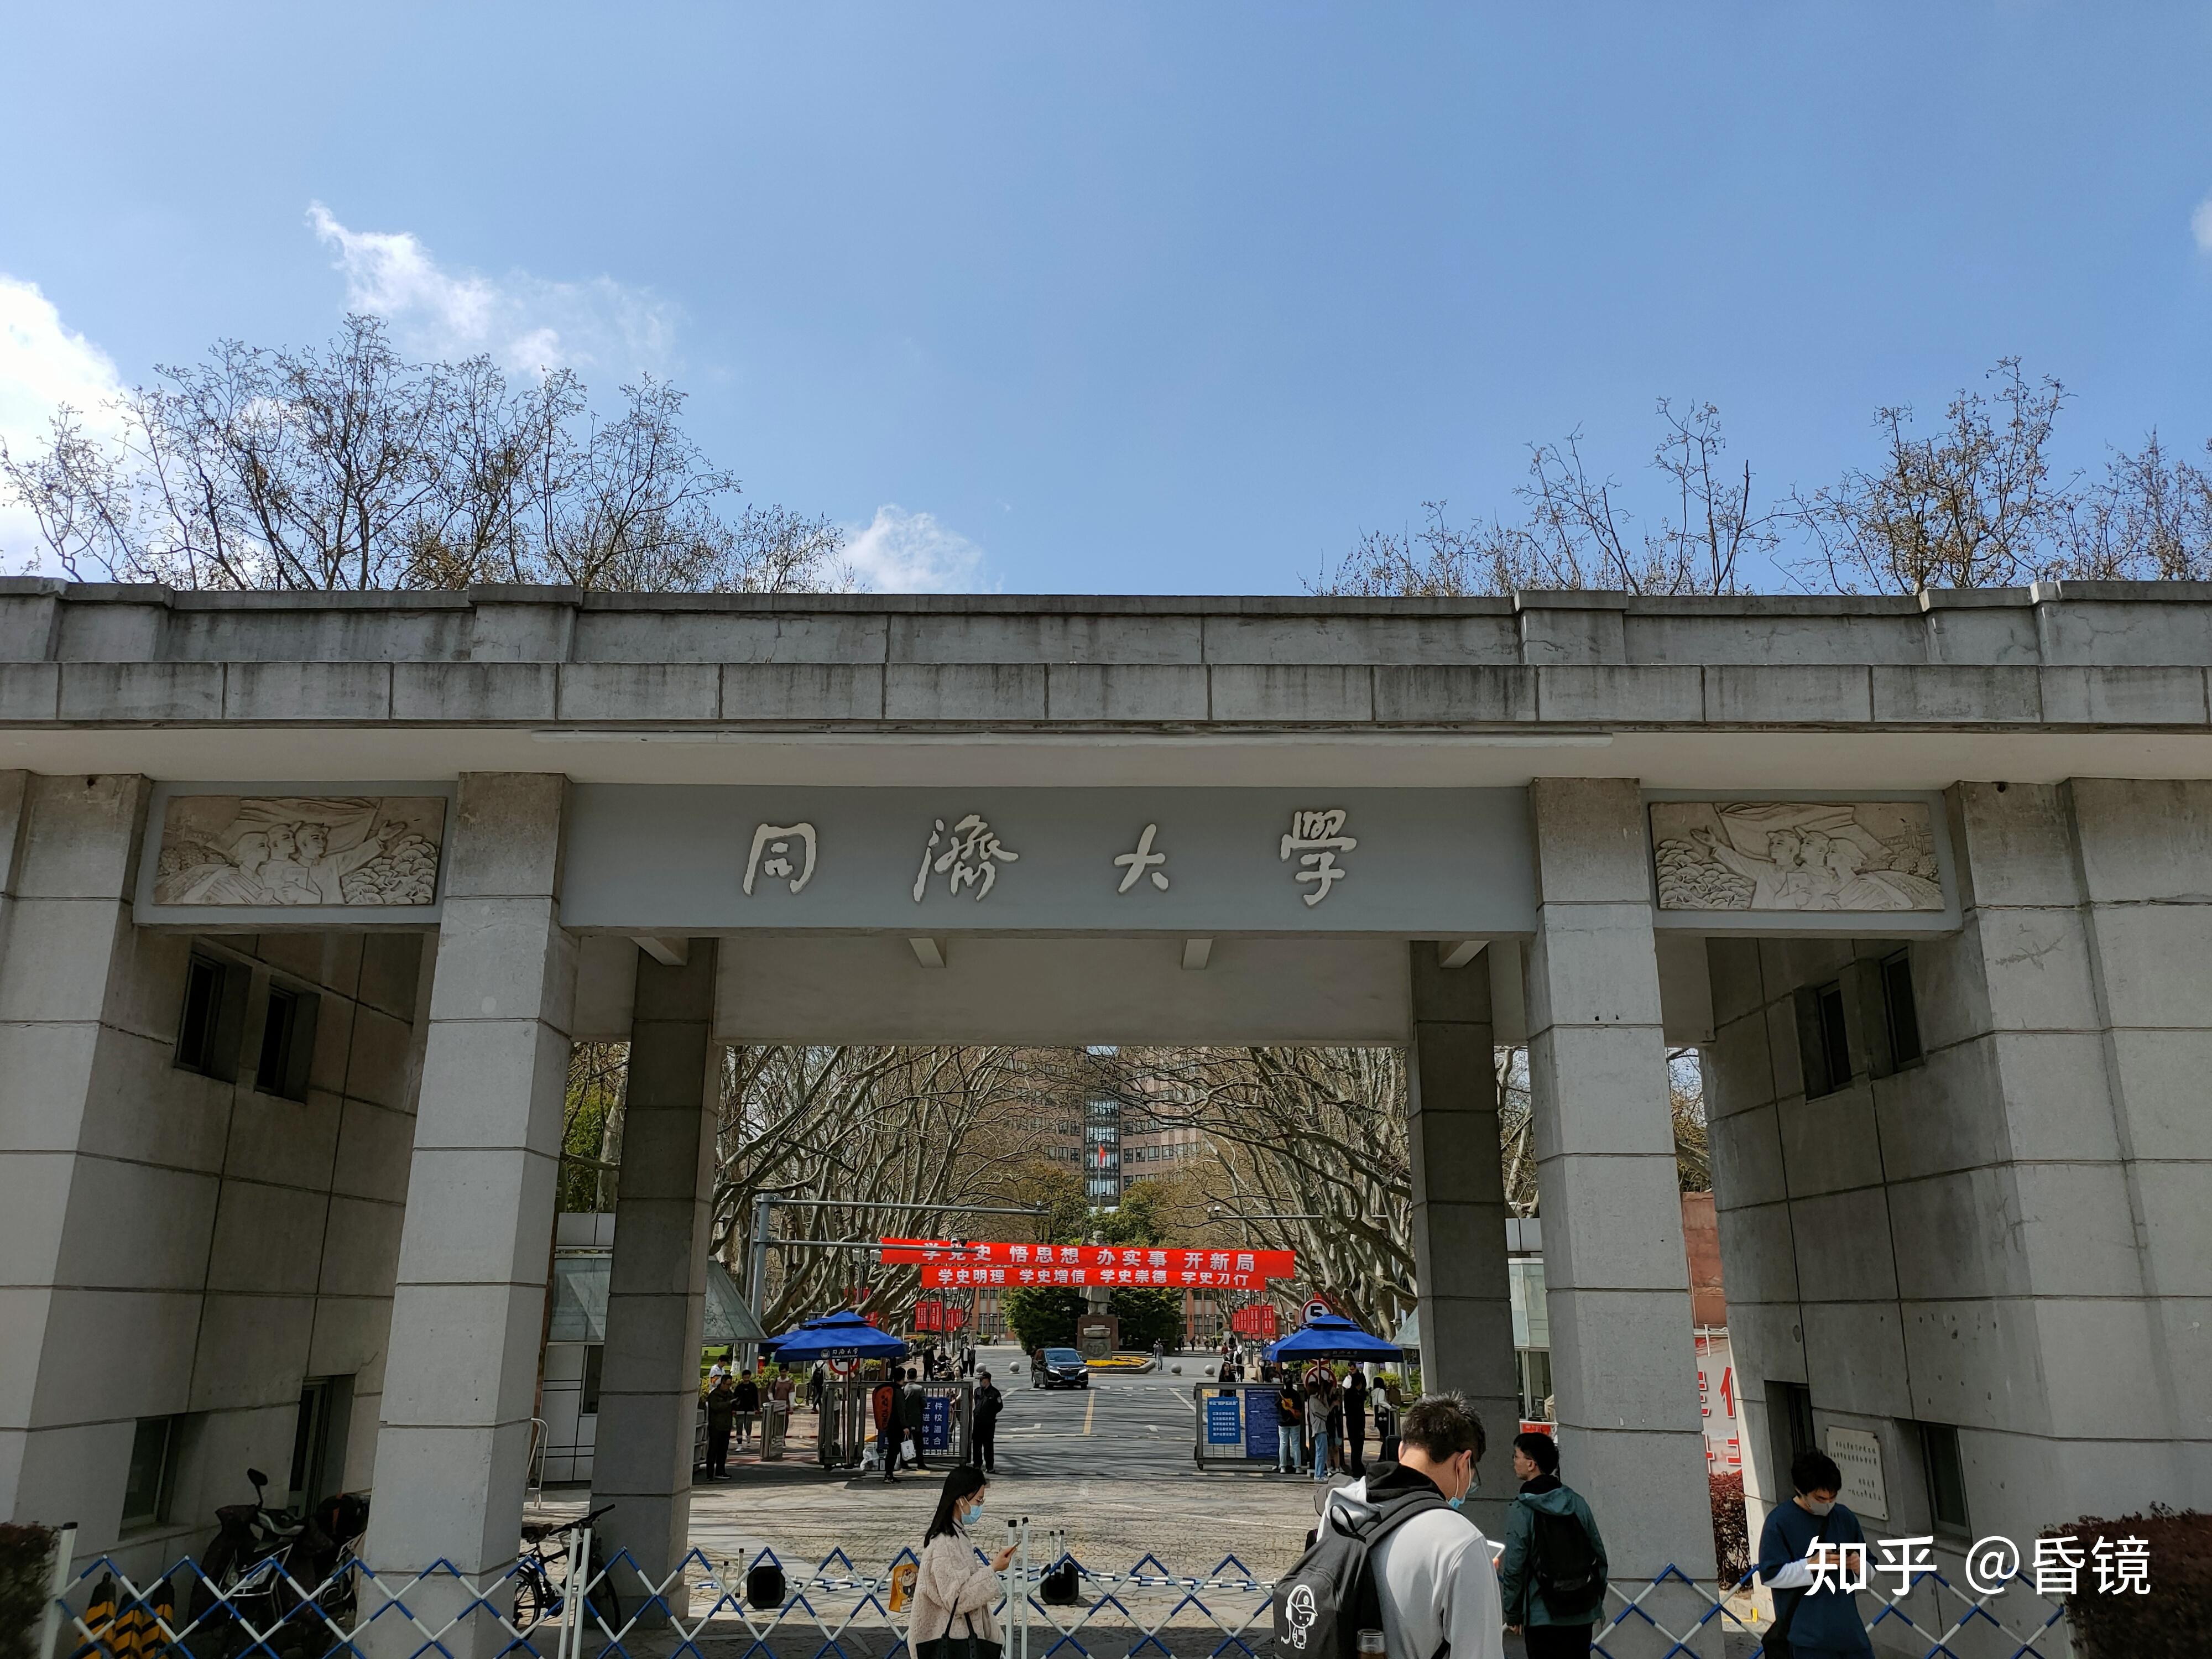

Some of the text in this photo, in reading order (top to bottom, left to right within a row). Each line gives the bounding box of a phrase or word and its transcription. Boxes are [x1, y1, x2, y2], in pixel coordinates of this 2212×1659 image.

[1009, 1245, 1079, 1264] 悟思想
[1097, 1249, 1168, 1268] 办实事
[1184, 1253, 1255, 1272] 开新局
[938, 1269, 1005, 1285] 学史明理
[1019, 1269, 1086, 1284] 学史增信
[1100, 1269, 1167, 1284] 学史崇德
[922, 1413, 942, 1422] 进校
[922, 1425, 942, 1433] 体温
